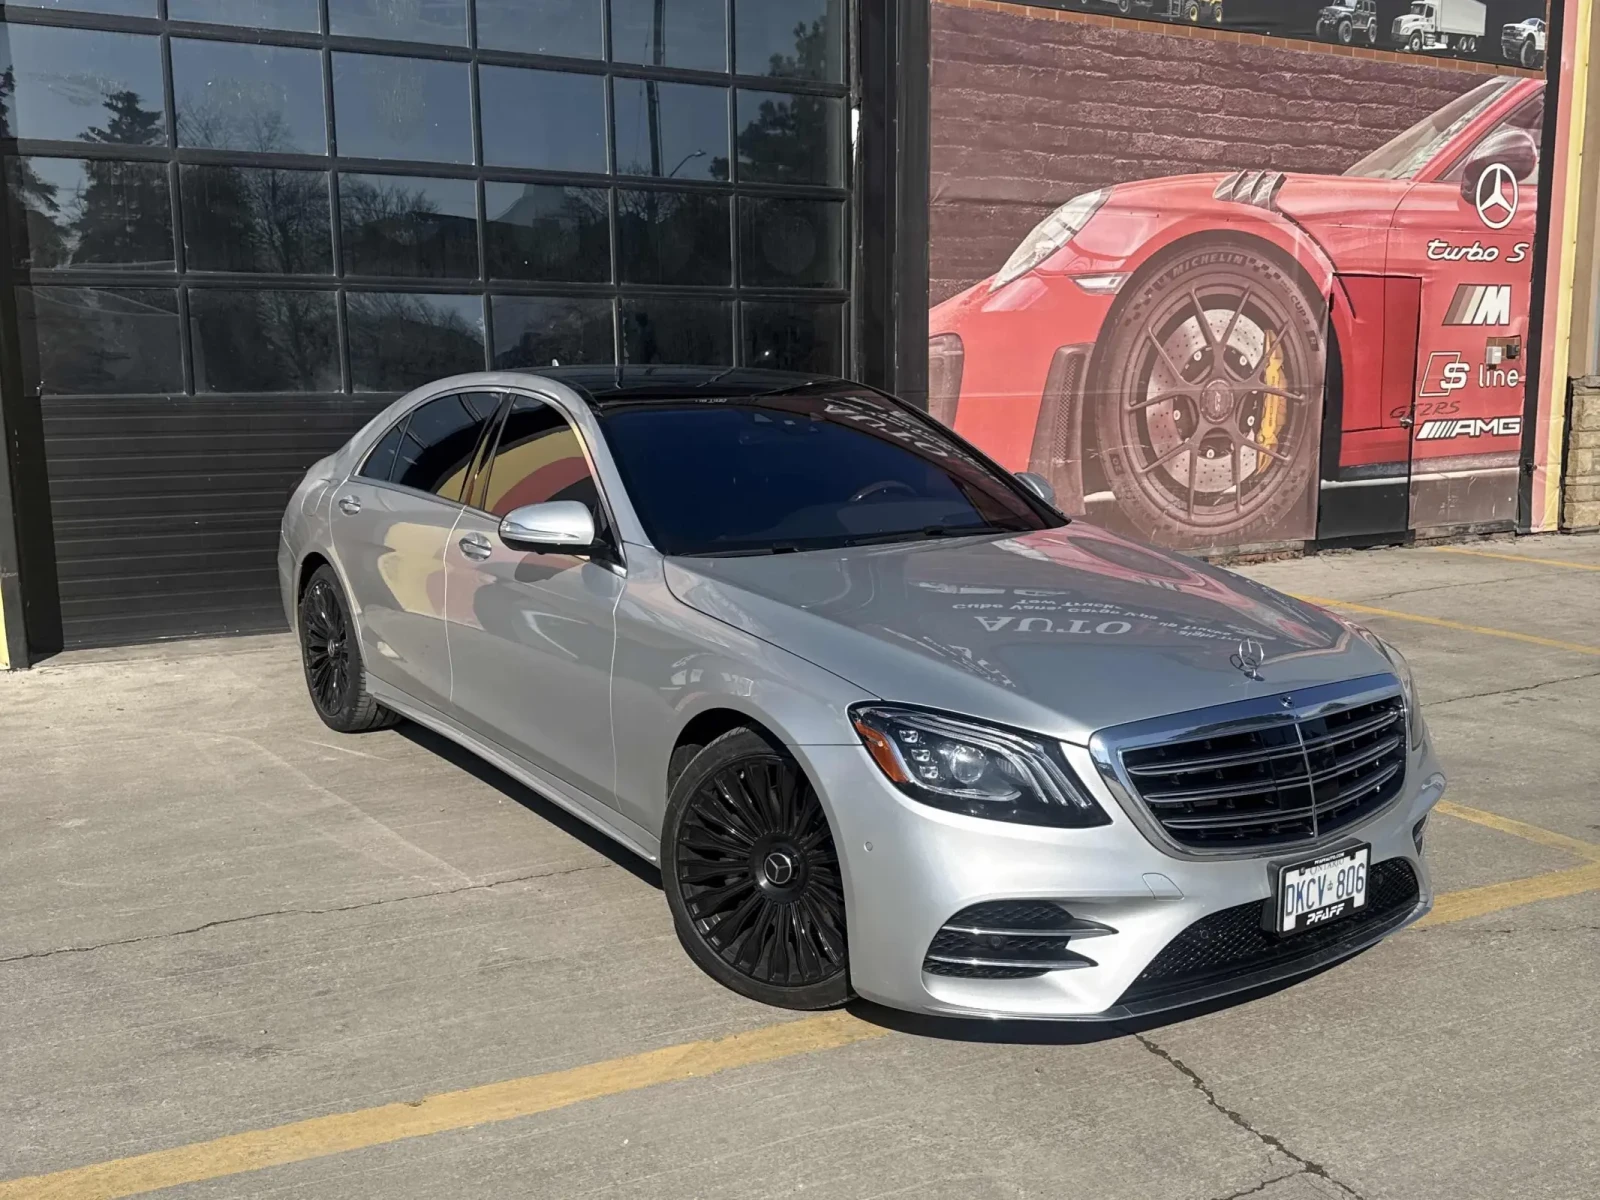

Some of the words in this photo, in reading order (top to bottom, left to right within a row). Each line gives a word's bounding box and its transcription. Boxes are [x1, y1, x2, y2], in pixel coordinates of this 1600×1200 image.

[1427, 239, 1499, 262] turbo
[1505, 243, 1530, 263] S
[1172, 252, 1244, 277] MICHELIN
[1290, 294, 1308, 318] CUP
[1440, 362, 1471, 390] S
[1479, 364, 1519, 387] line
[1451, 417, 1521, 437] AMG
[1285, 874, 1327, 917] DKCV
[1336, 862, 1365, 899] 806
[1306, 902, 1345, 926] PFAFF
